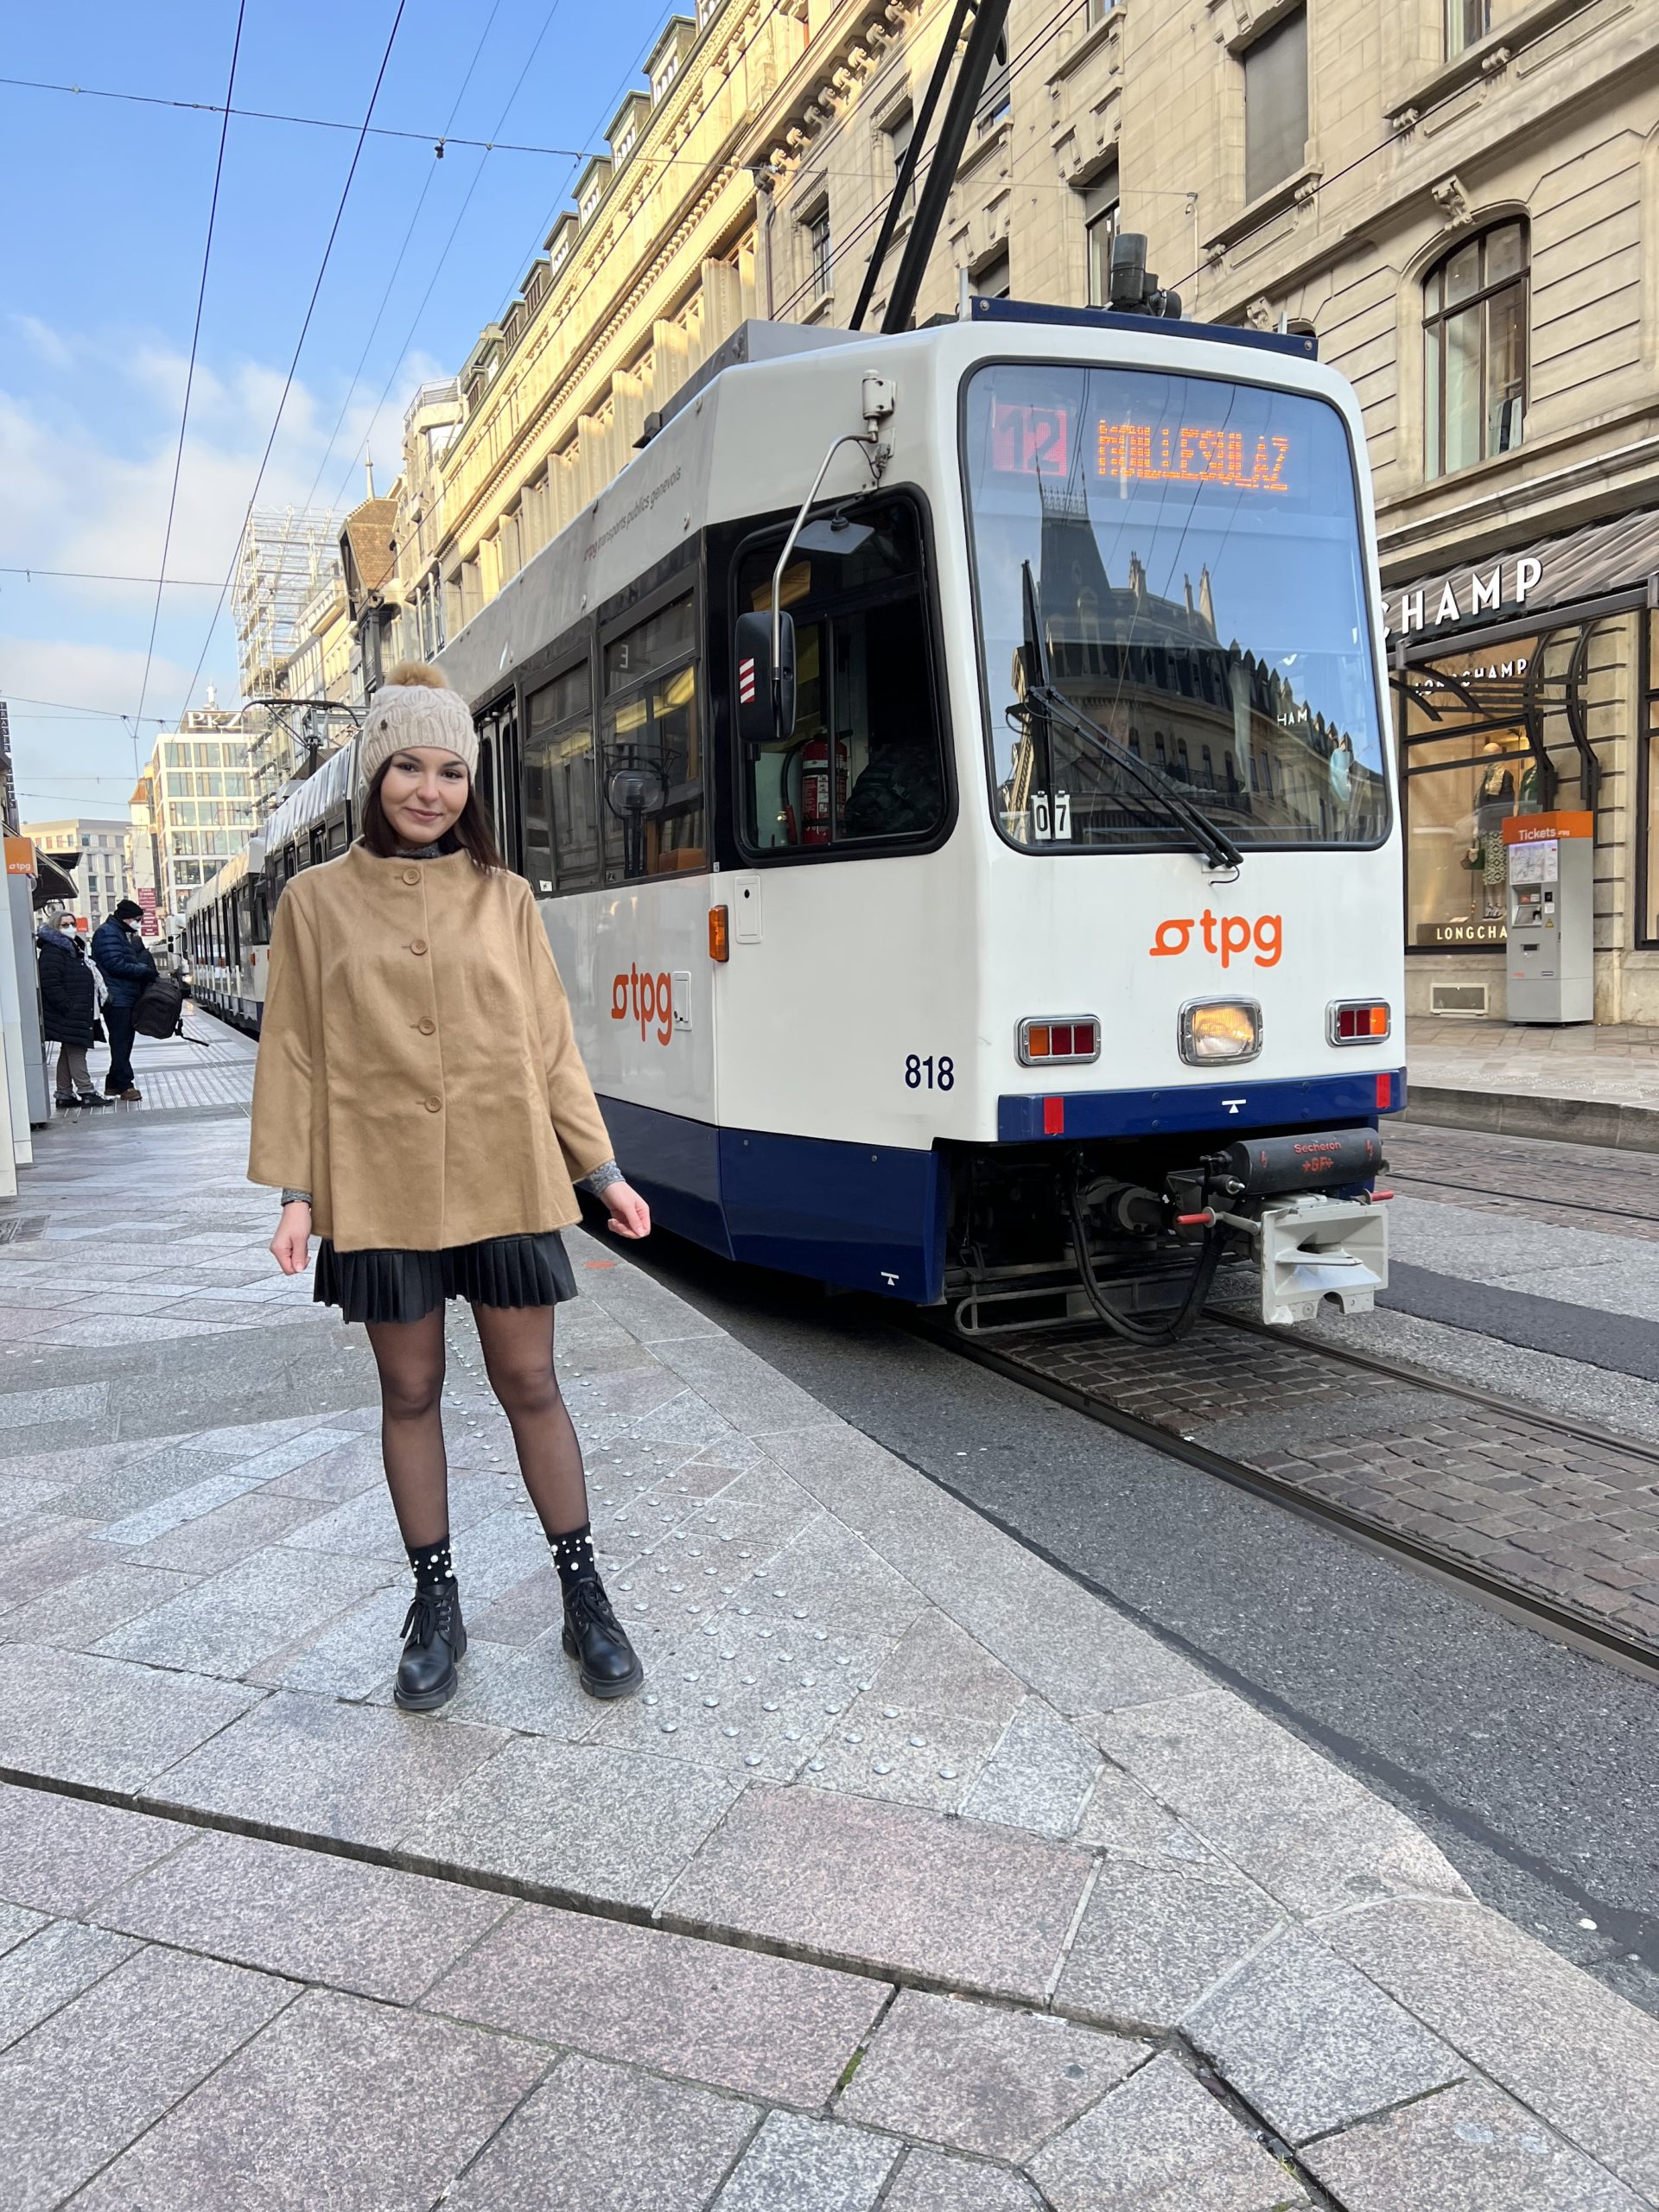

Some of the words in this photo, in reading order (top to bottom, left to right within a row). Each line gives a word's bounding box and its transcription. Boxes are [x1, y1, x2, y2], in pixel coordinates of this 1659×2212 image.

[999, 408, 1061, 473] 12
[598, 516, 626, 550] transports
[626, 495, 650, 531] publics
[650, 466, 682, 510] genevois
[1036, 804, 1067, 832] 07
[1518, 828, 1556, 841] Tickets
[905, 1053, 955, 1091] 818
